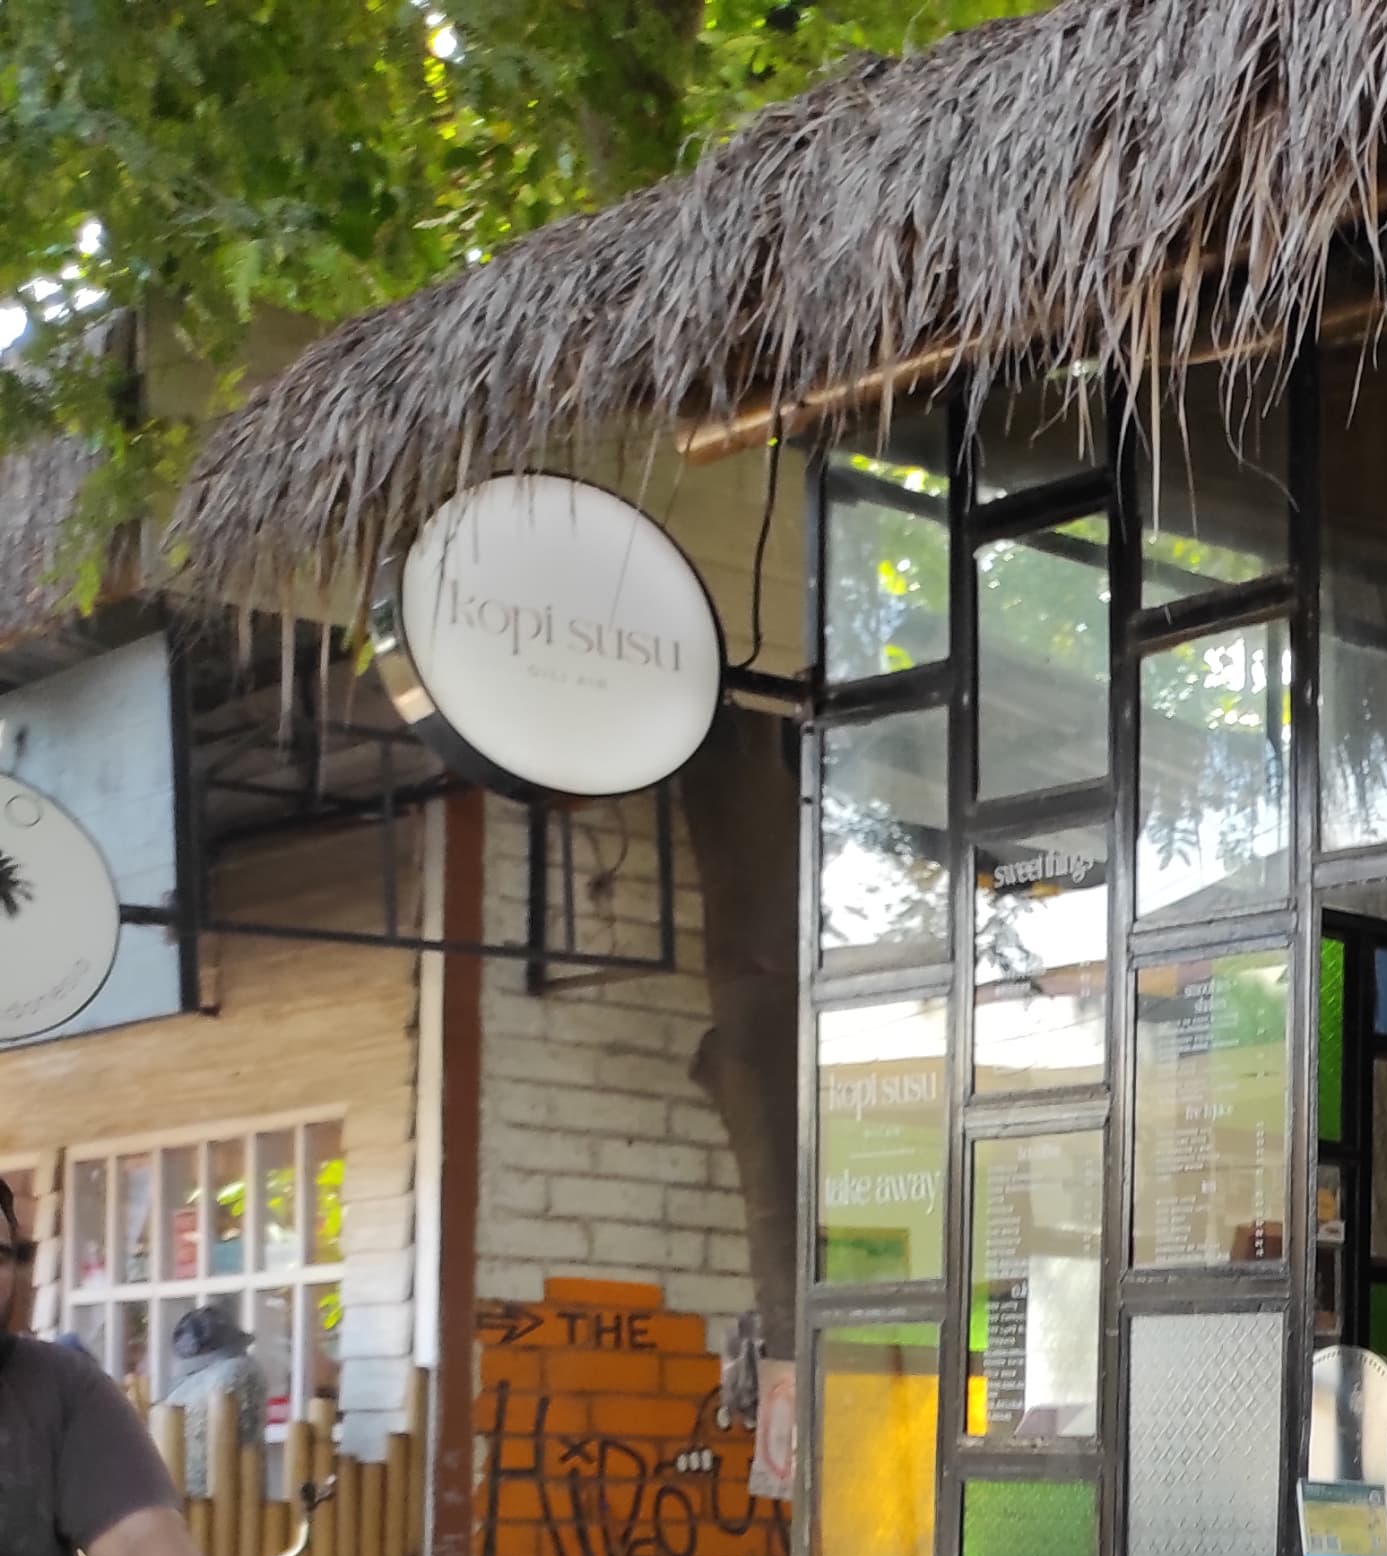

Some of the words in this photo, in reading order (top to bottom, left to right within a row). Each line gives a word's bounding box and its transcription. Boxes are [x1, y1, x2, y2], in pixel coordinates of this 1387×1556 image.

[448, 579, 554, 656] kopi
[567, 618, 683, 672] susu
[828, 1071, 877, 1121] kopi
[882, 1071, 937, 1105] susu
[875, 1169, 942, 1216] away
[556, 1311, 657, 1349] THE
